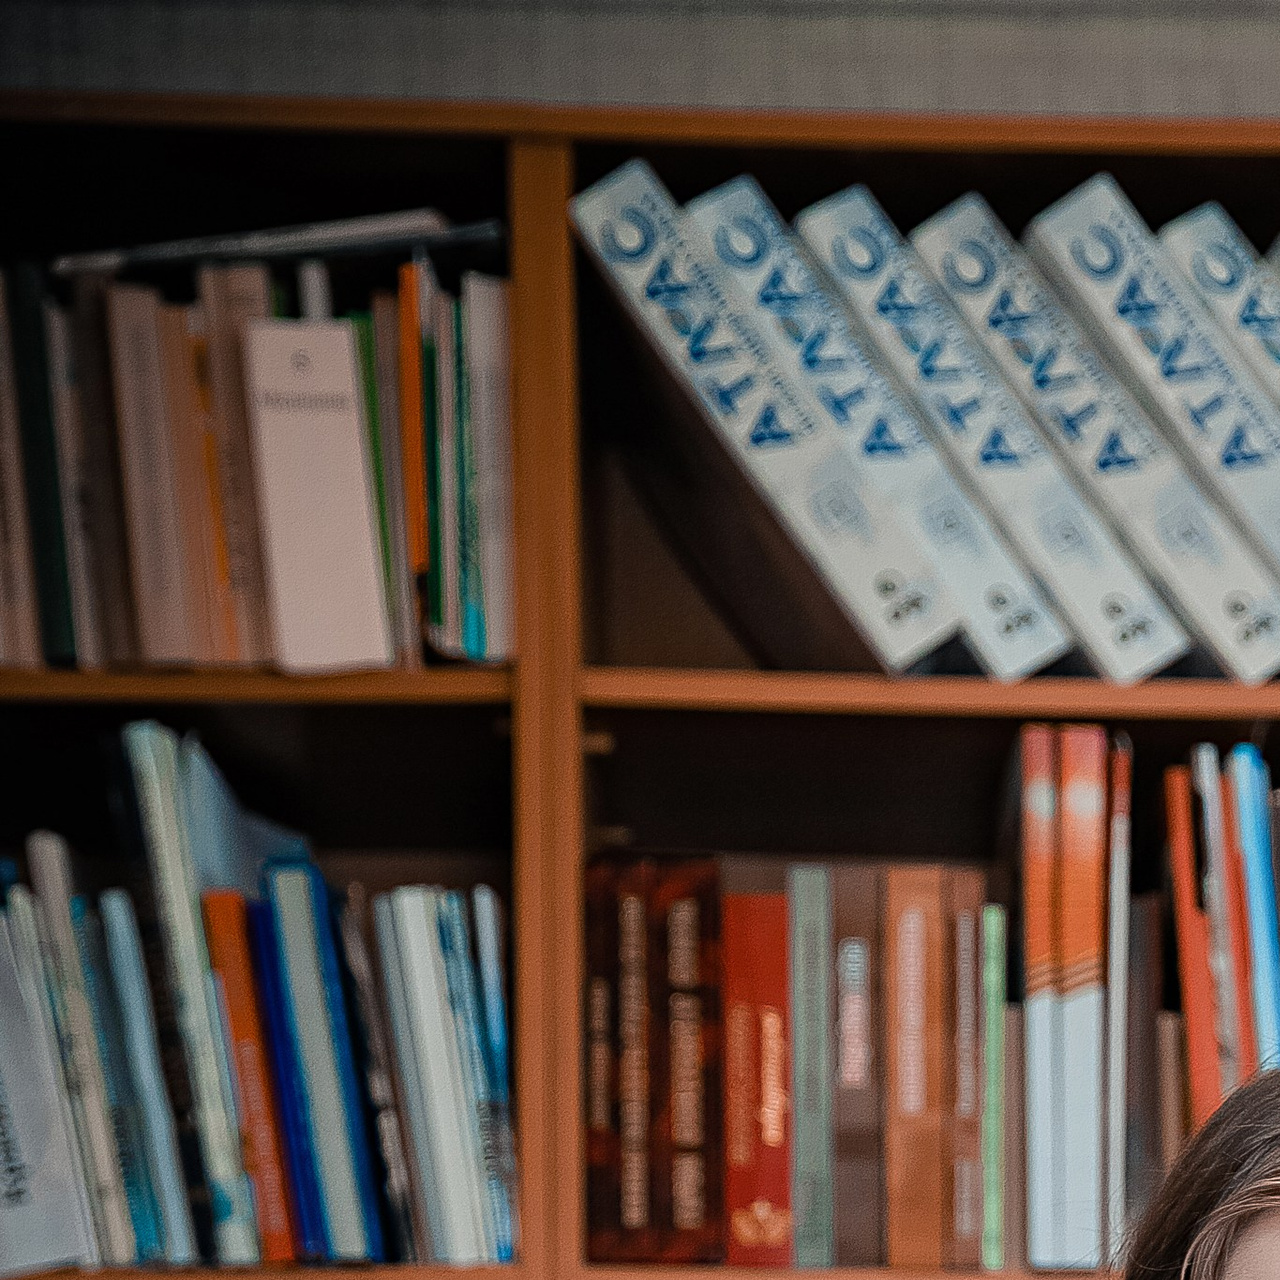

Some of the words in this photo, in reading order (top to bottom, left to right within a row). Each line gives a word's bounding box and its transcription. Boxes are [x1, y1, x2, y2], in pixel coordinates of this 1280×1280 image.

[603, 206, 793, 446] АТЛАС
[714, 213, 904, 457] АТЛАС
[830, 223, 1021, 465] АТЛАС
[942, 238, 1137, 472] АТЛАС
[1069, 224, 1261, 466] АТЛАС
